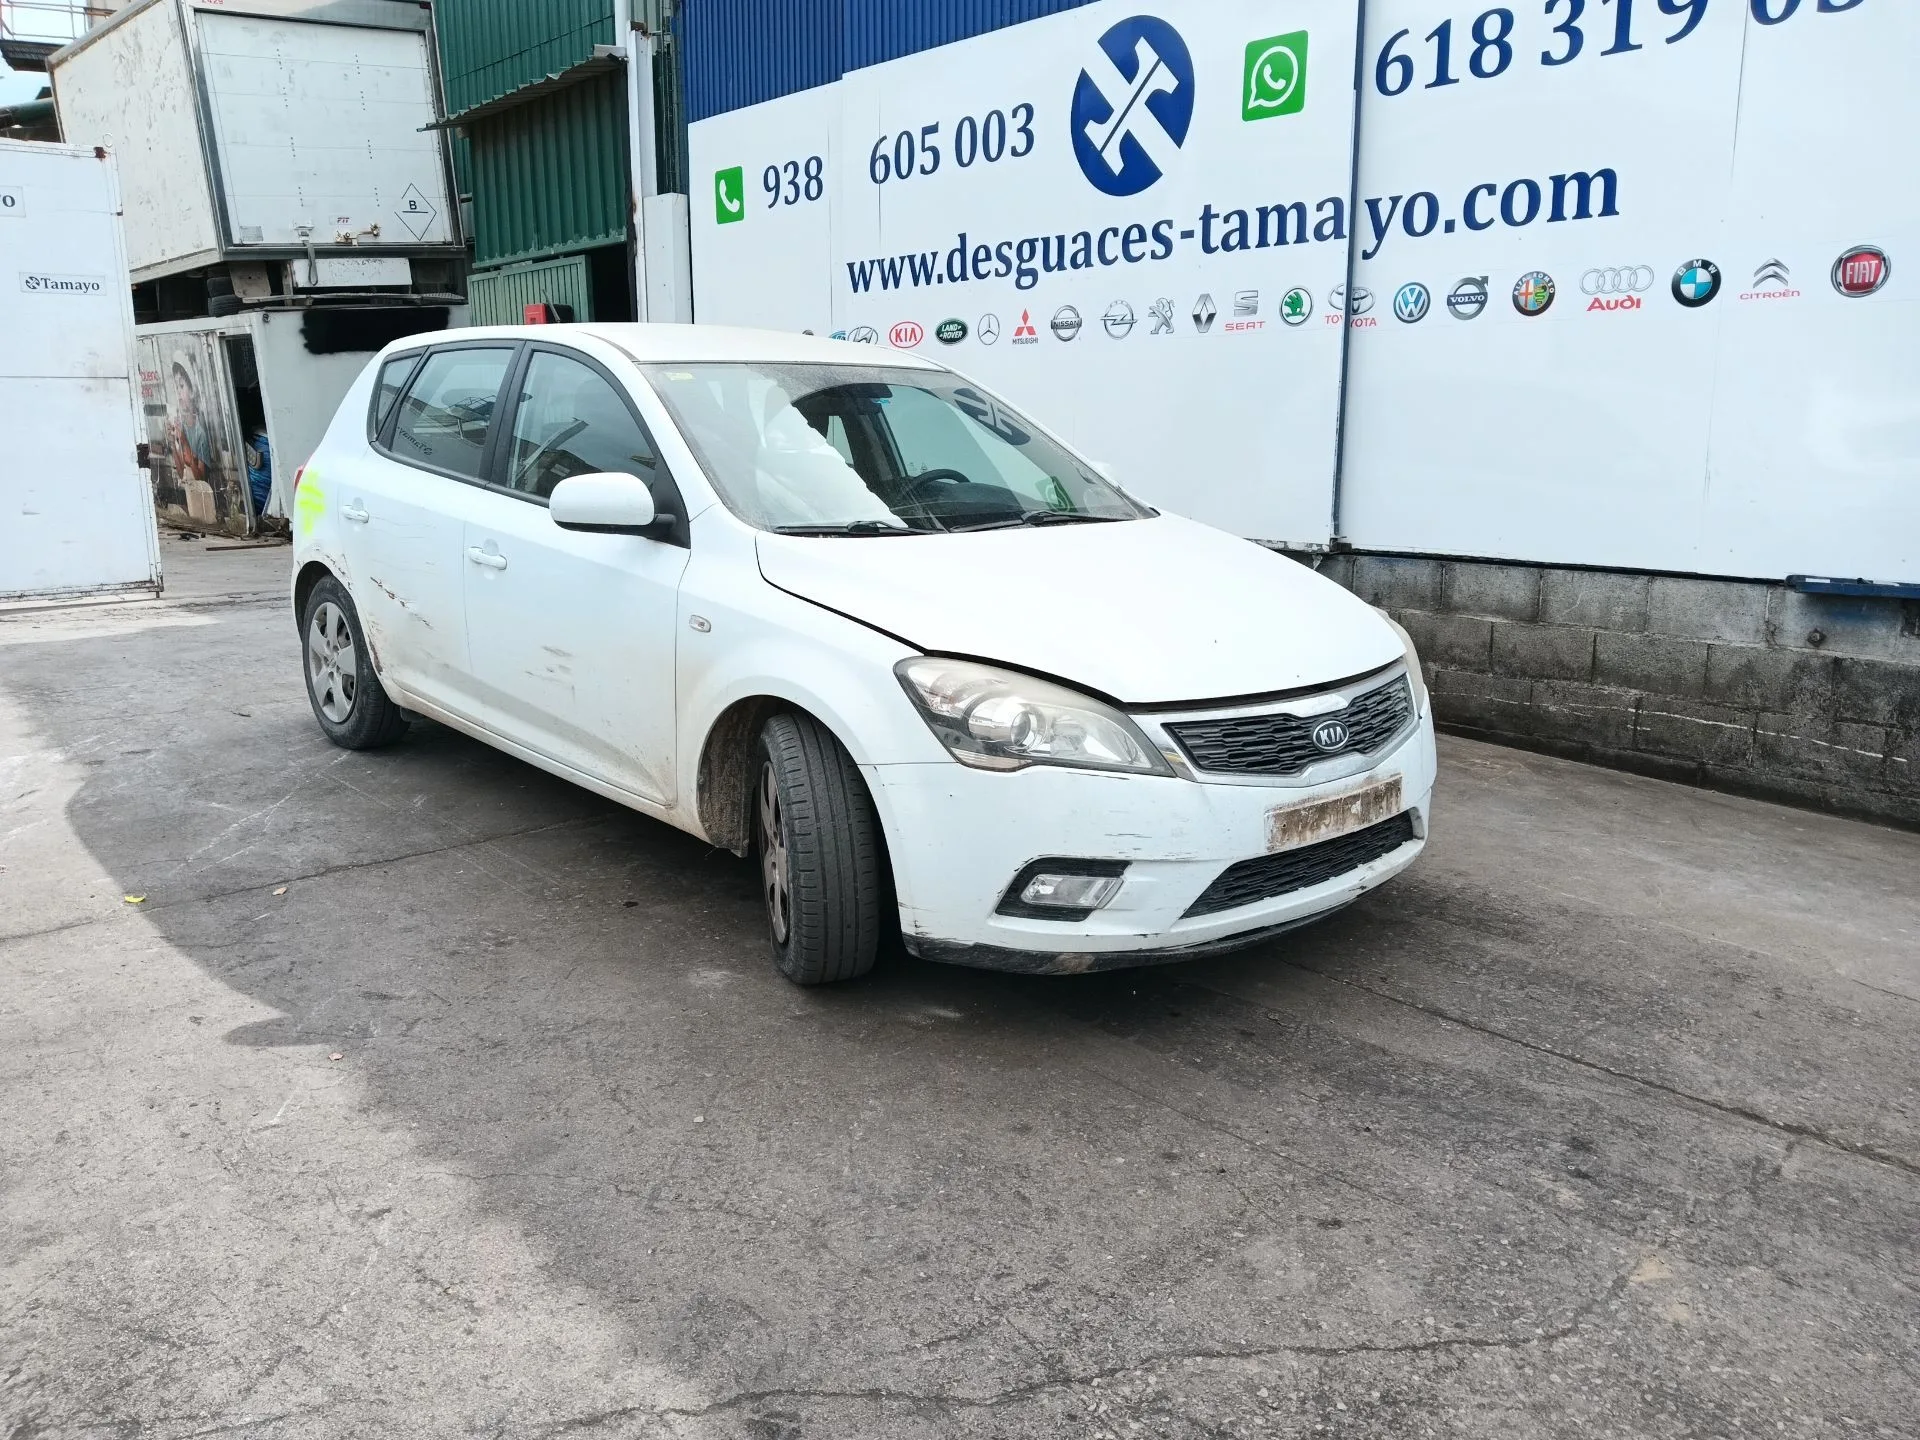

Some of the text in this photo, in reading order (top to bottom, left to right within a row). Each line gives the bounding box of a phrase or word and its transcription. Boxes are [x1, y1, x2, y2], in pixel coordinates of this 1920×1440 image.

[1375, 8, 1514, 97] 618
[763, 102, 1035, 209] 938 605 003
[408, 200, 418, 211] B
[1845, 259, 1880, 284] FIAT
[40, 277, 100, 294] Tamayo
[1450, 294, 1486, 303] VOLVO
[1586, 294, 1642, 312] Audi
[941, 323, 959, 332] LAND
[1053, 320, 1079, 328] NISSAN
[1225, 321, 1266, 331] SEAT
[895, 327, 917, 342] KIA
[942, 331, 962, 339] ROVER
[1318, 727, 1345, 746] KIA
